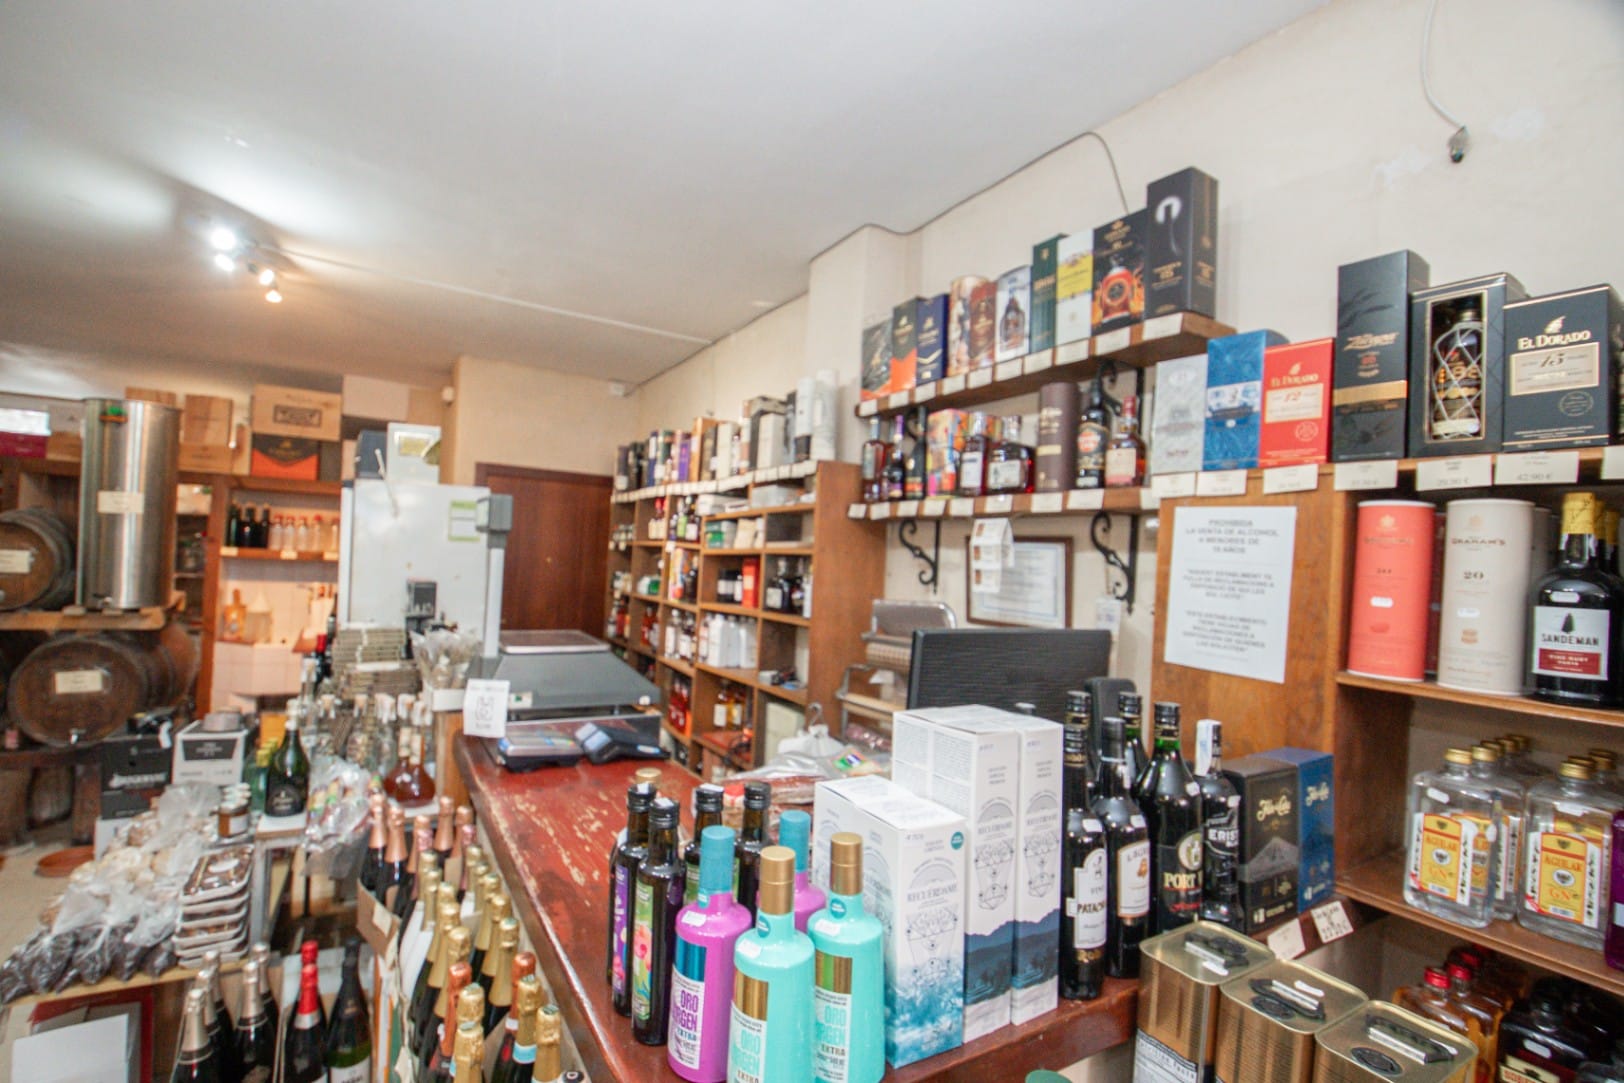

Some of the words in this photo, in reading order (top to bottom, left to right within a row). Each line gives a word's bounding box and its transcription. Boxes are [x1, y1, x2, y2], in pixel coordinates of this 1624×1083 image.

[1518, 338, 1535, 350] EL
[1536, 330, 1592, 349] DORADO
[1540, 353, 1565, 368] 15
[1464, 571, 1484, 580] 20
[1541, 633, 1599, 646] SANDEMAN
[1545, 855, 1582, 872] AGUILAR
[1164, 871, 1196, 888] PORT
[681, 989, 699, 1013] ORO
[821, 1043, 846, 1056] EXTRA
